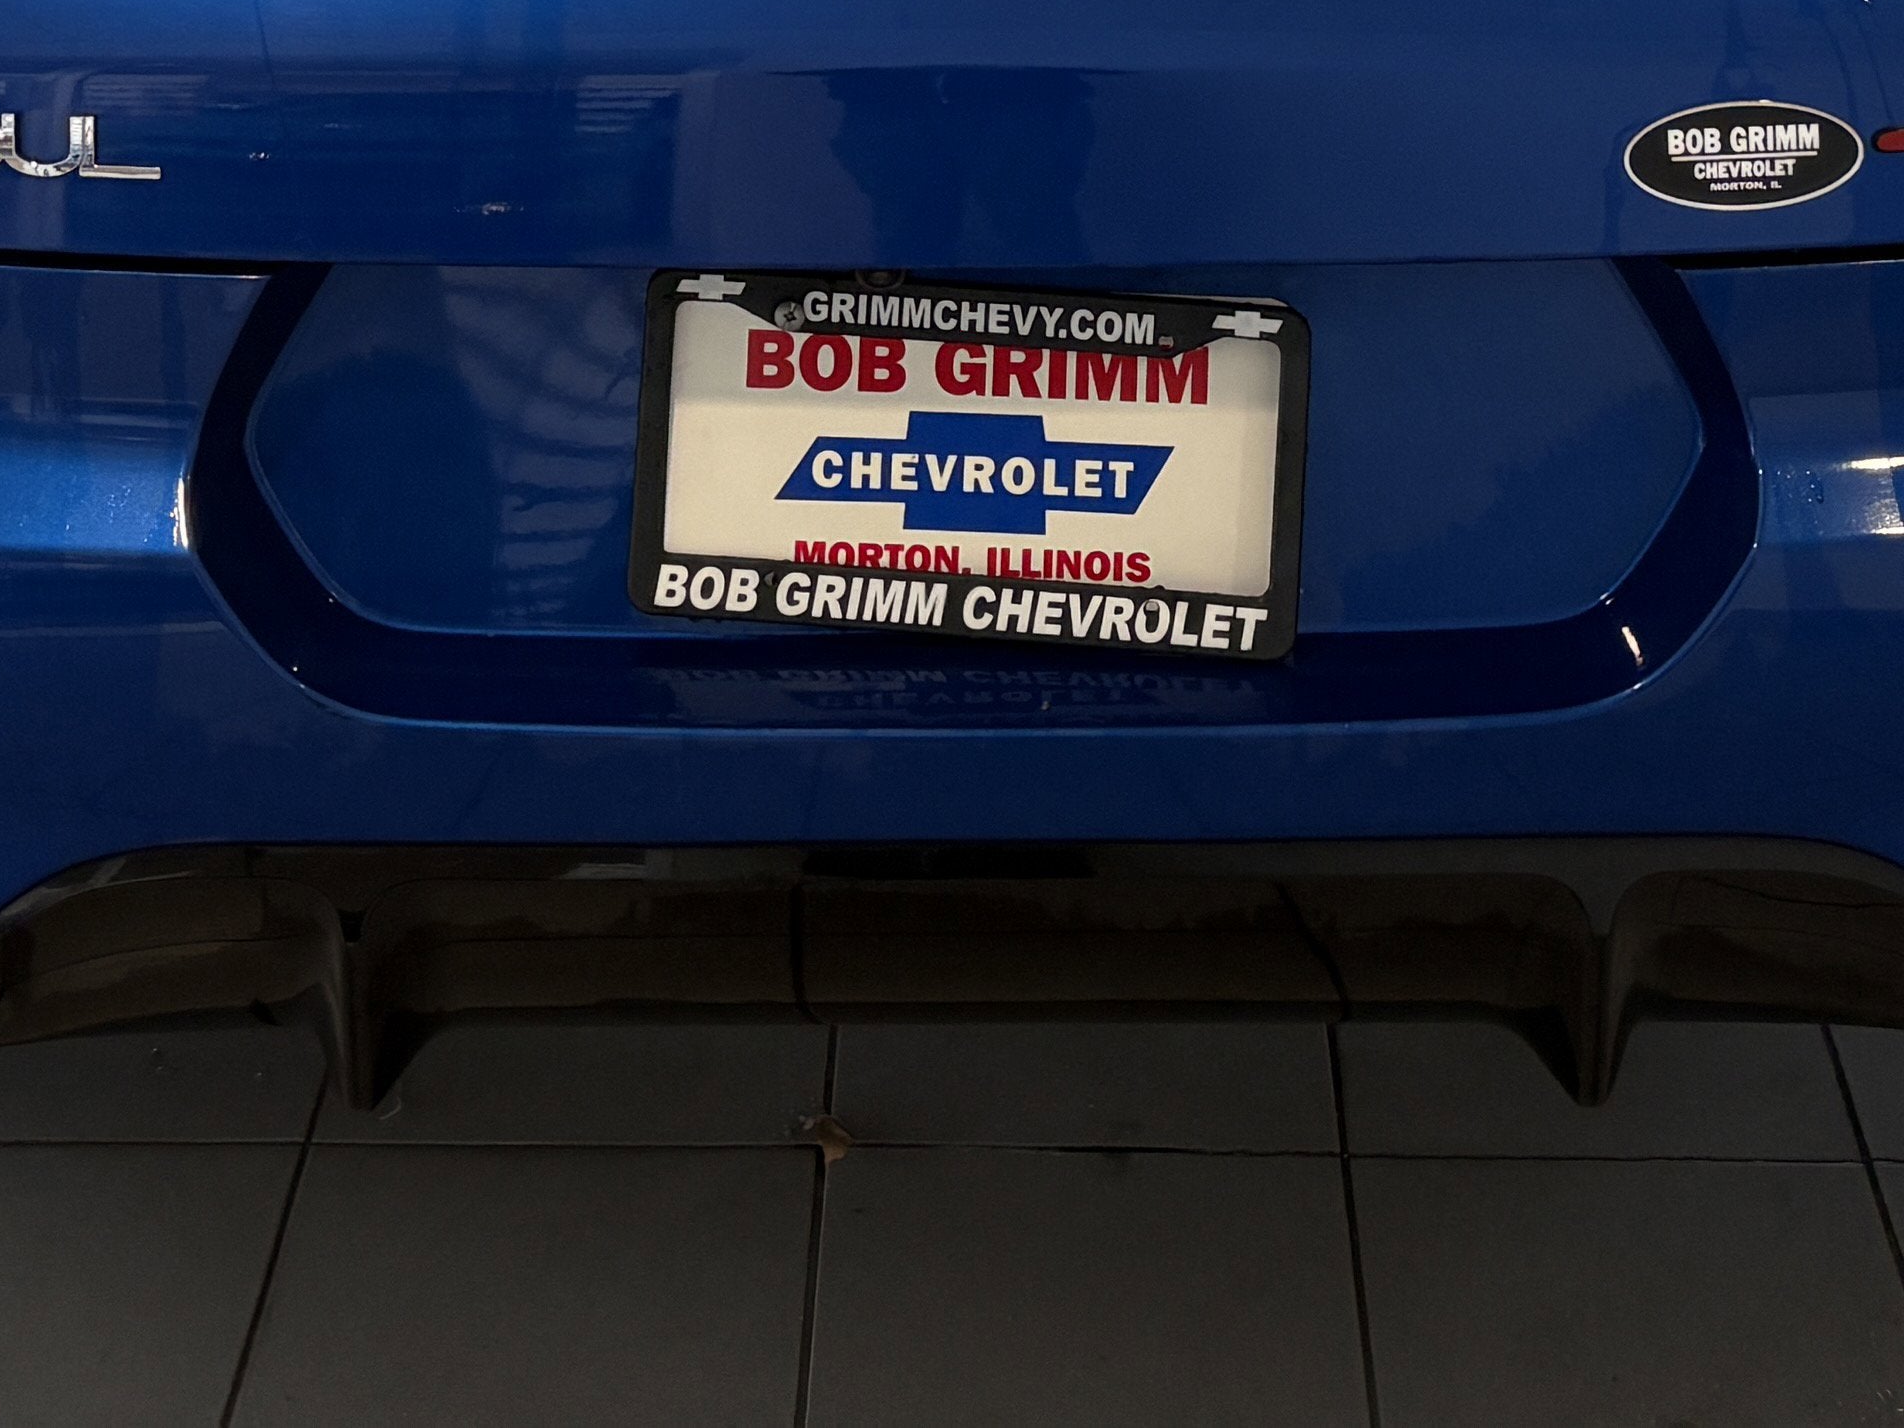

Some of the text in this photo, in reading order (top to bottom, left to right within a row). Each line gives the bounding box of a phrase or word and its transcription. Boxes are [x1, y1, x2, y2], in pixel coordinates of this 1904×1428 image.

[1667, 123, 1820, 155] BOB GRIMM
[1693, 158, 1796, 180] CHEVROLET
[803, 291, 1155, 346] GRIMMCHEVY.COM
[746, 329, 1209, 405] BOB GRIMM
[811, 450, 1134, 498] CHEVROLET
[987, 547, 1152, 583] ILLINOIS
[653, 564, 1268, 651] BOB GRIMM CHEVROLET
